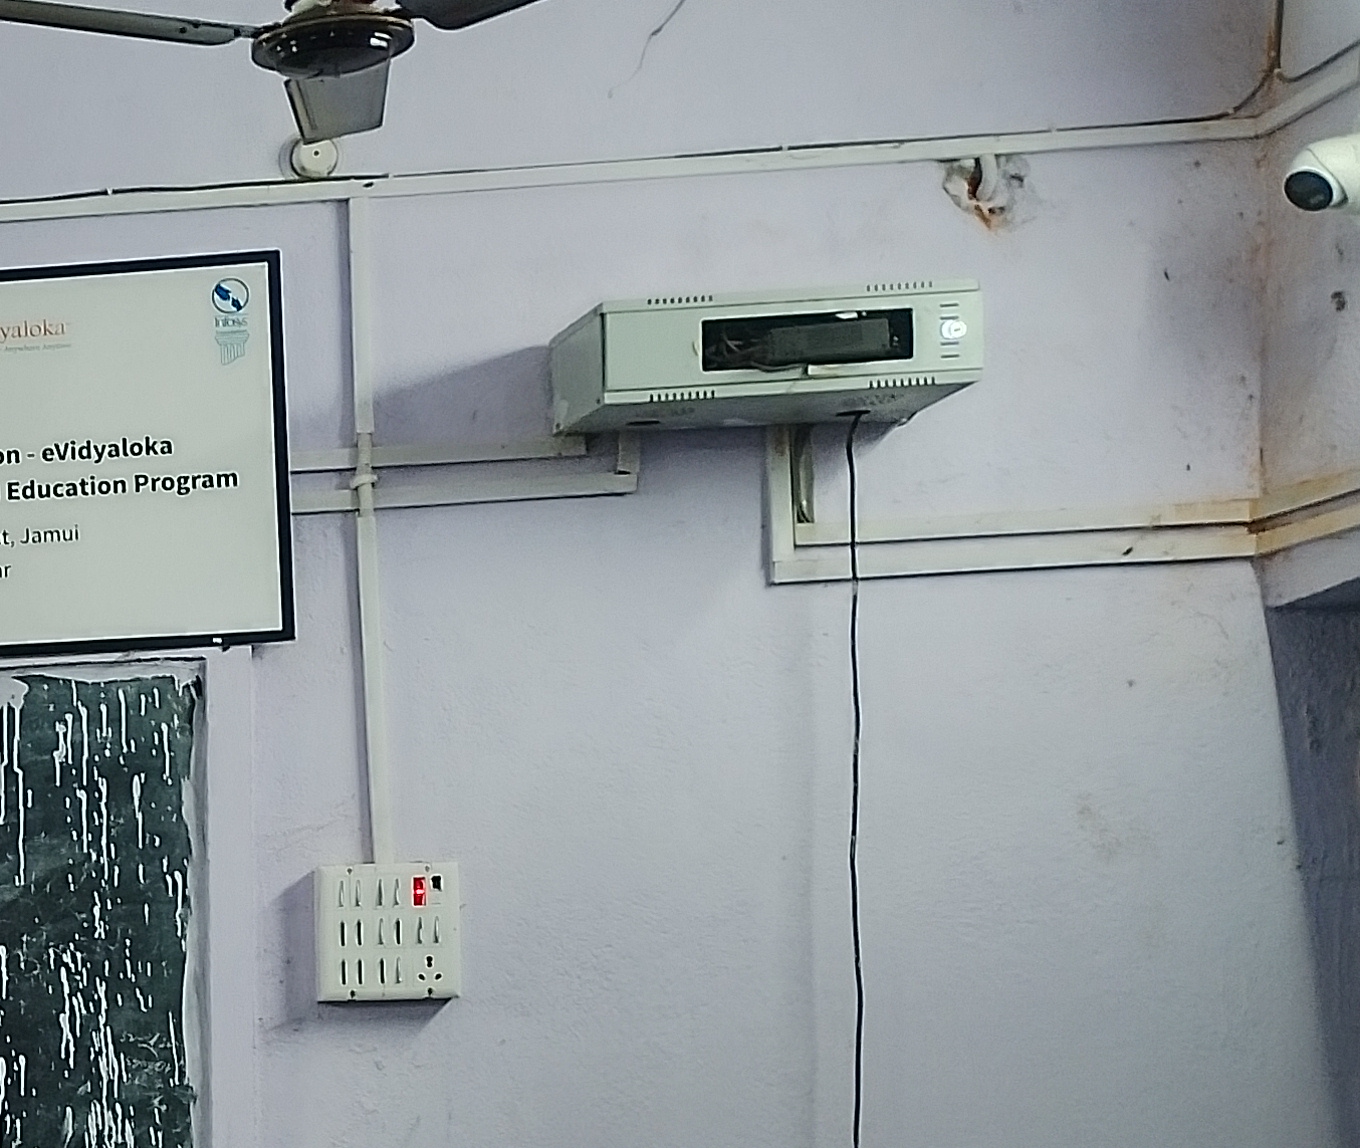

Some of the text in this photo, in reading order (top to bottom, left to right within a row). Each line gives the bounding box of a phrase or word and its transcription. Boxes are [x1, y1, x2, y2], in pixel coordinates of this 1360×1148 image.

[41, 436, 173, 463] eVidyaloka
[7, 475, 127, 501] Education
[134, 472, 238, 496] Program
[20, 524, 79, 544] Jamui
